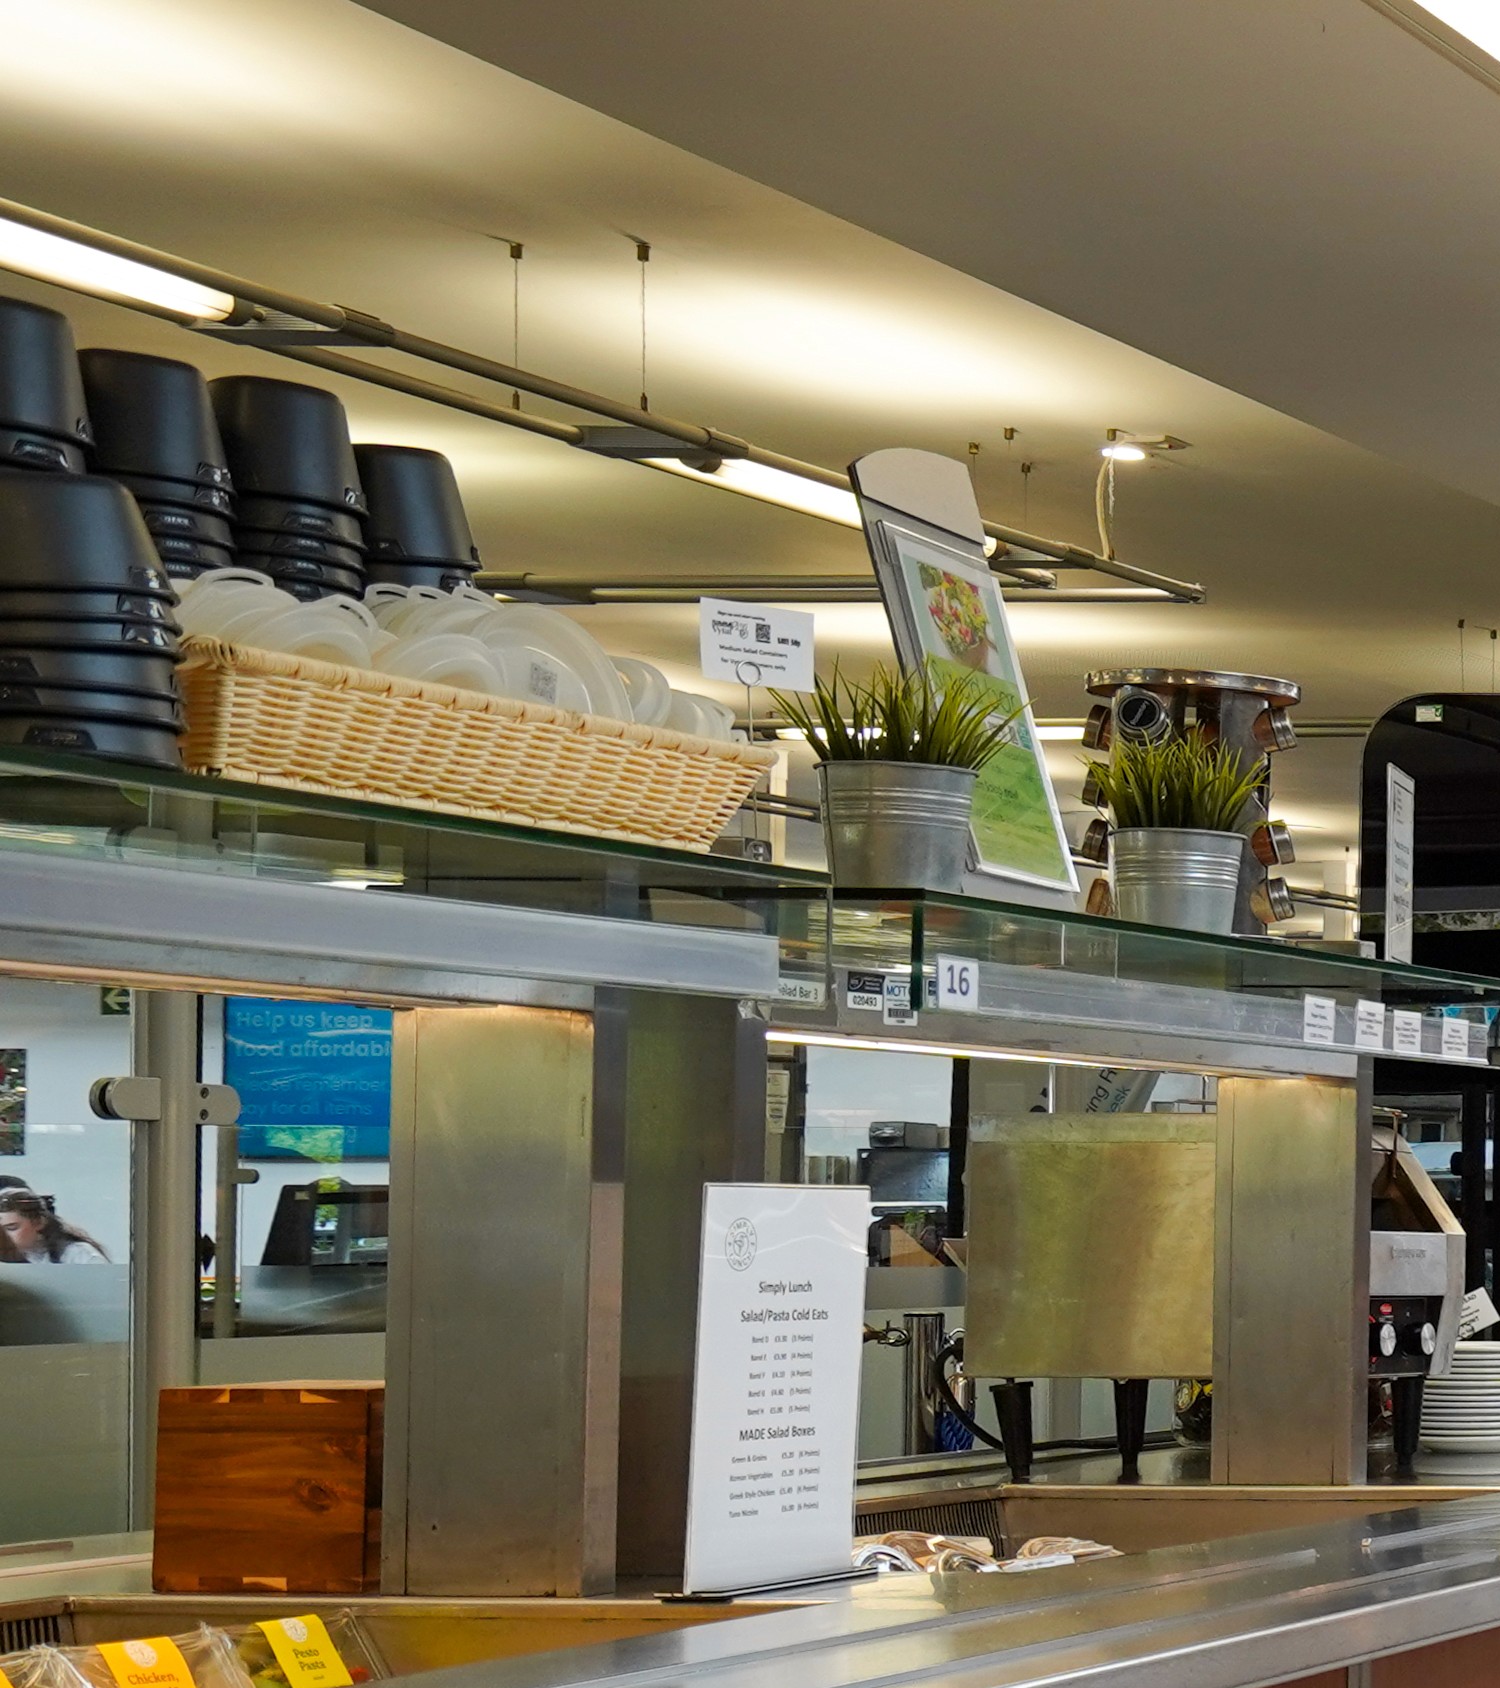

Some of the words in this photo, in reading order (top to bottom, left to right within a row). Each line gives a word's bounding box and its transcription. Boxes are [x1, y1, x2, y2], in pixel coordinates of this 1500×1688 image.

[946, 964, 970, 996] 16
[800, 986, 812, 998] Bar
[813, 988, 818, 1000] 3
[853, 994, 878, 1007] 020493
[236, 1010, 285, 1033] Help
[290, 1014, 315, 1028] us
[320, 1011, 373, 1030] keep
[271, 1101, 294, 1115] for
[301, 1101, 319, 1115] all
[322, 1101, 373, 1115] items
[758, 1280, 787, 1296] Simply
[789, 1279, 813, 1293] Lunch
[741, 1308, 790, 1324] Salad/Pasta
[792, 1308, 810, 1321] Cold
[812, 1308, 829, 1321] Eats
[739, 1429, 766, 1441] MADE
[768, 1426, 789, 1439] Salad
[792, 1426, 815, 1437] Boxes
[731, 1455, 746, 1464] Green
[757, 1489, 775, 1497] Chicken
[729, 1510, 741, 1518] Tuna
[292, 1648, 320, 1660] Pesto
[299, 1660, 326, 1672] Pasta
[127, 1672, 179, 1685] Chicken,
